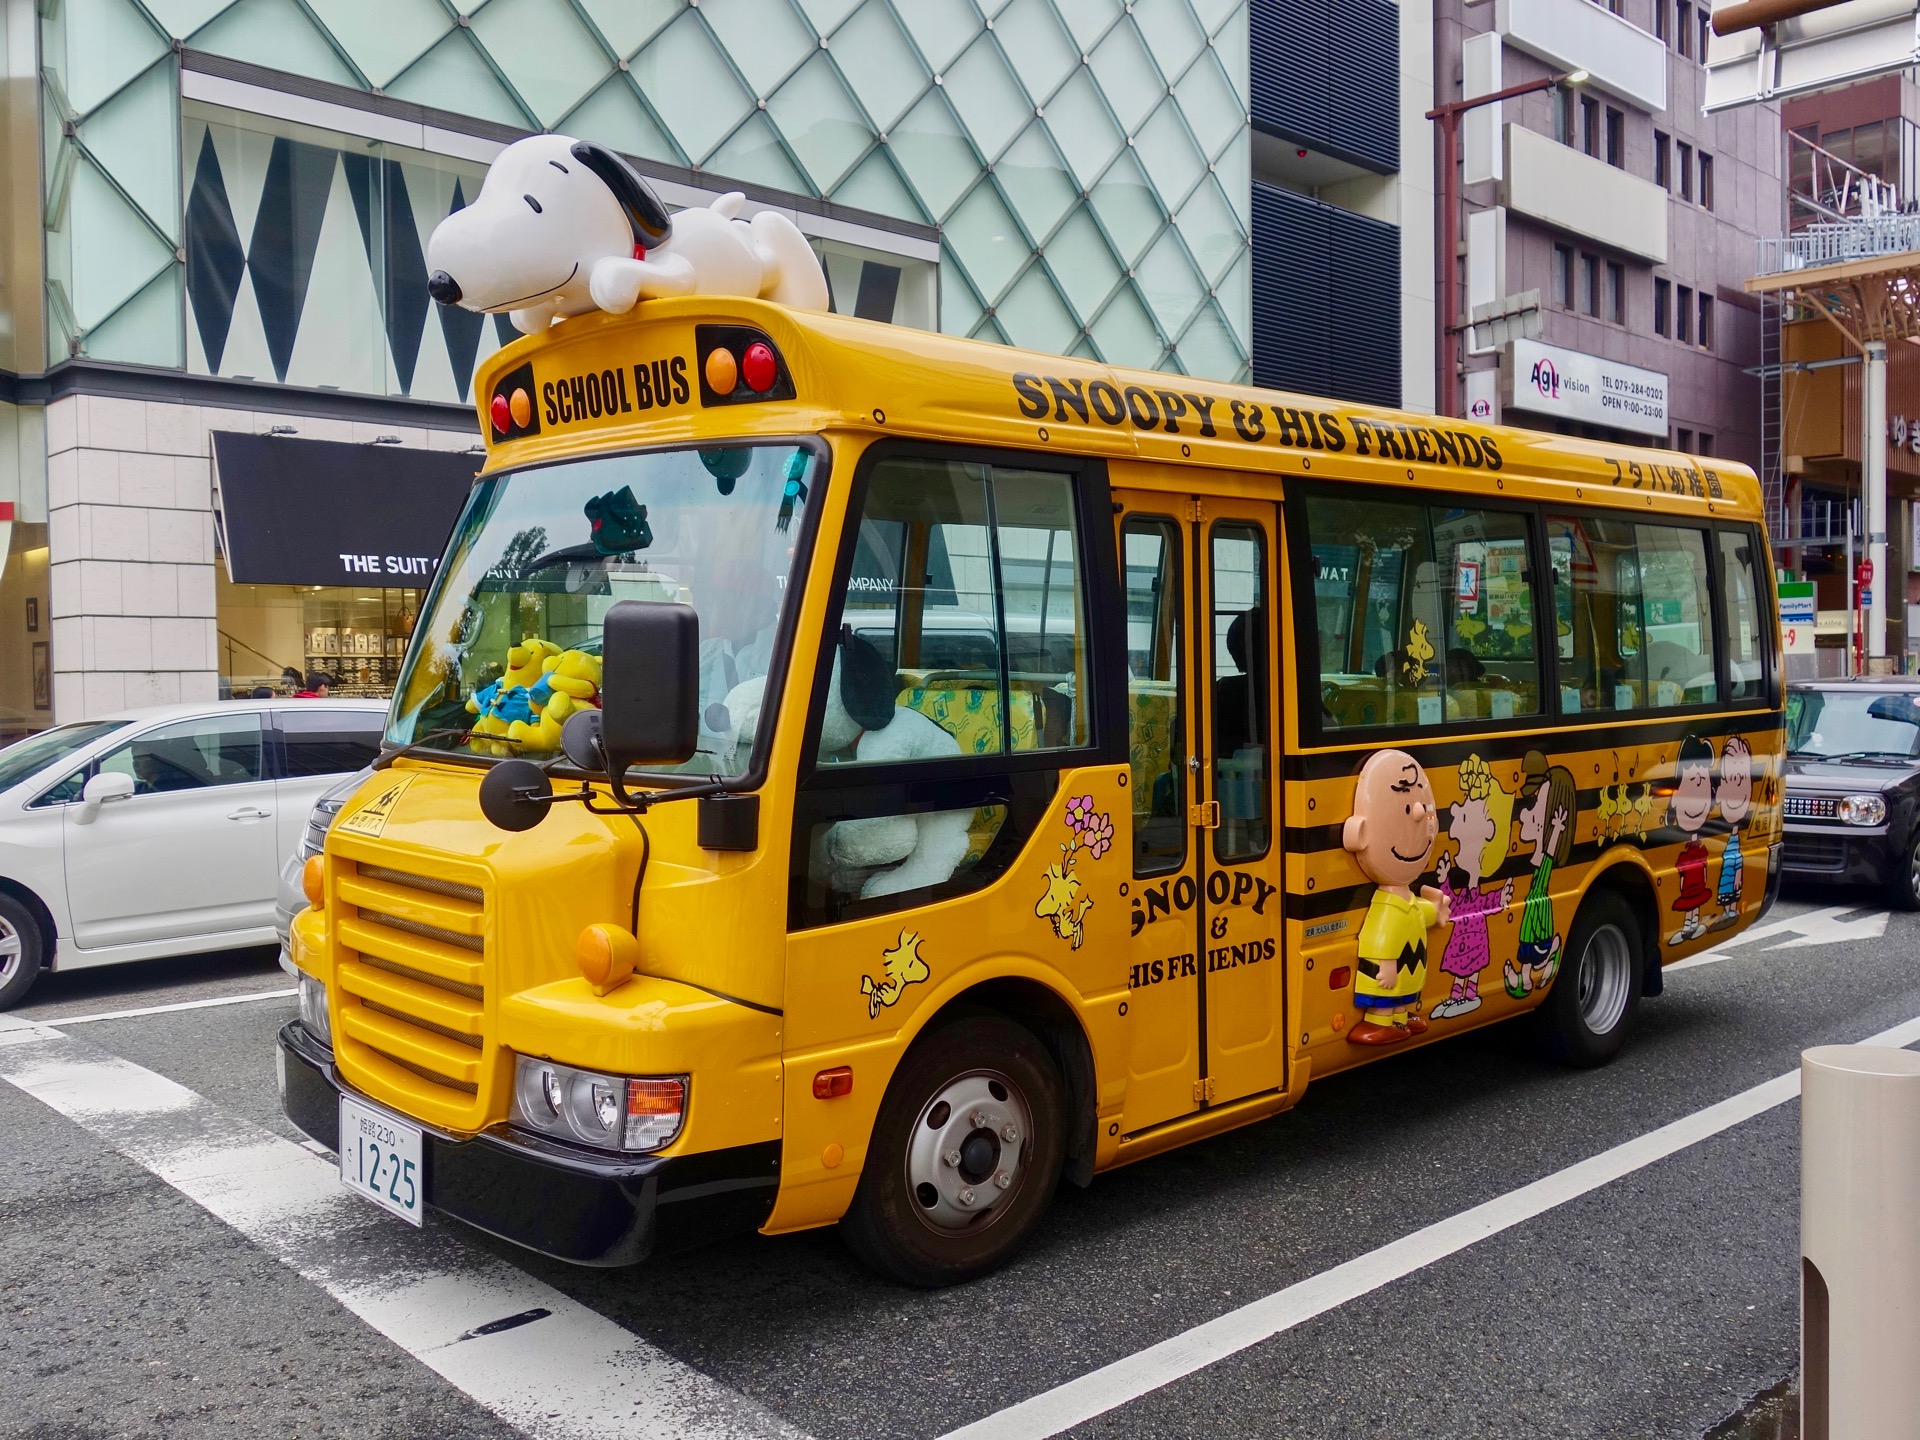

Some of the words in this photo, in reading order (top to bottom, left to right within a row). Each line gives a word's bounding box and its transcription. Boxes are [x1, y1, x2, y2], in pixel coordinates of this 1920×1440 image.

[543, 368, 632, 426] SCHOOL
[634, 356, 690, 411] BUS
[1564, 378, 1590, 394] vision
[1602, 375, 1613, 389] TEL
[1615, 380, 1664, 400] 079-284-0202
[1602, 396, 1621, 410] OPEN
[1013, 372, 1217, 437] SNOOPY
[1230, 400, 1266, 442] &
[1271, 406, 1346, 452] HIS
[1347, 417, 1503, 471] FRIENDS
[1604, 458, 1722, 498] フタバ幼稚園
[339, 554, 381, 573] THE
[386, 557, 428, 575] SUIT
[1780, 602, 1812, 611] FamilyMart
[1210, 916, 1229, 940] &
[1128, 959, 1164, 990] HIS
[1167, 937, 1276, 981] FRIENDS
[360, 1116, 375, 1138] 姫路
[377, 1124, 396, 1147] 230
[359, 1136, 416, 1210] 12-25
